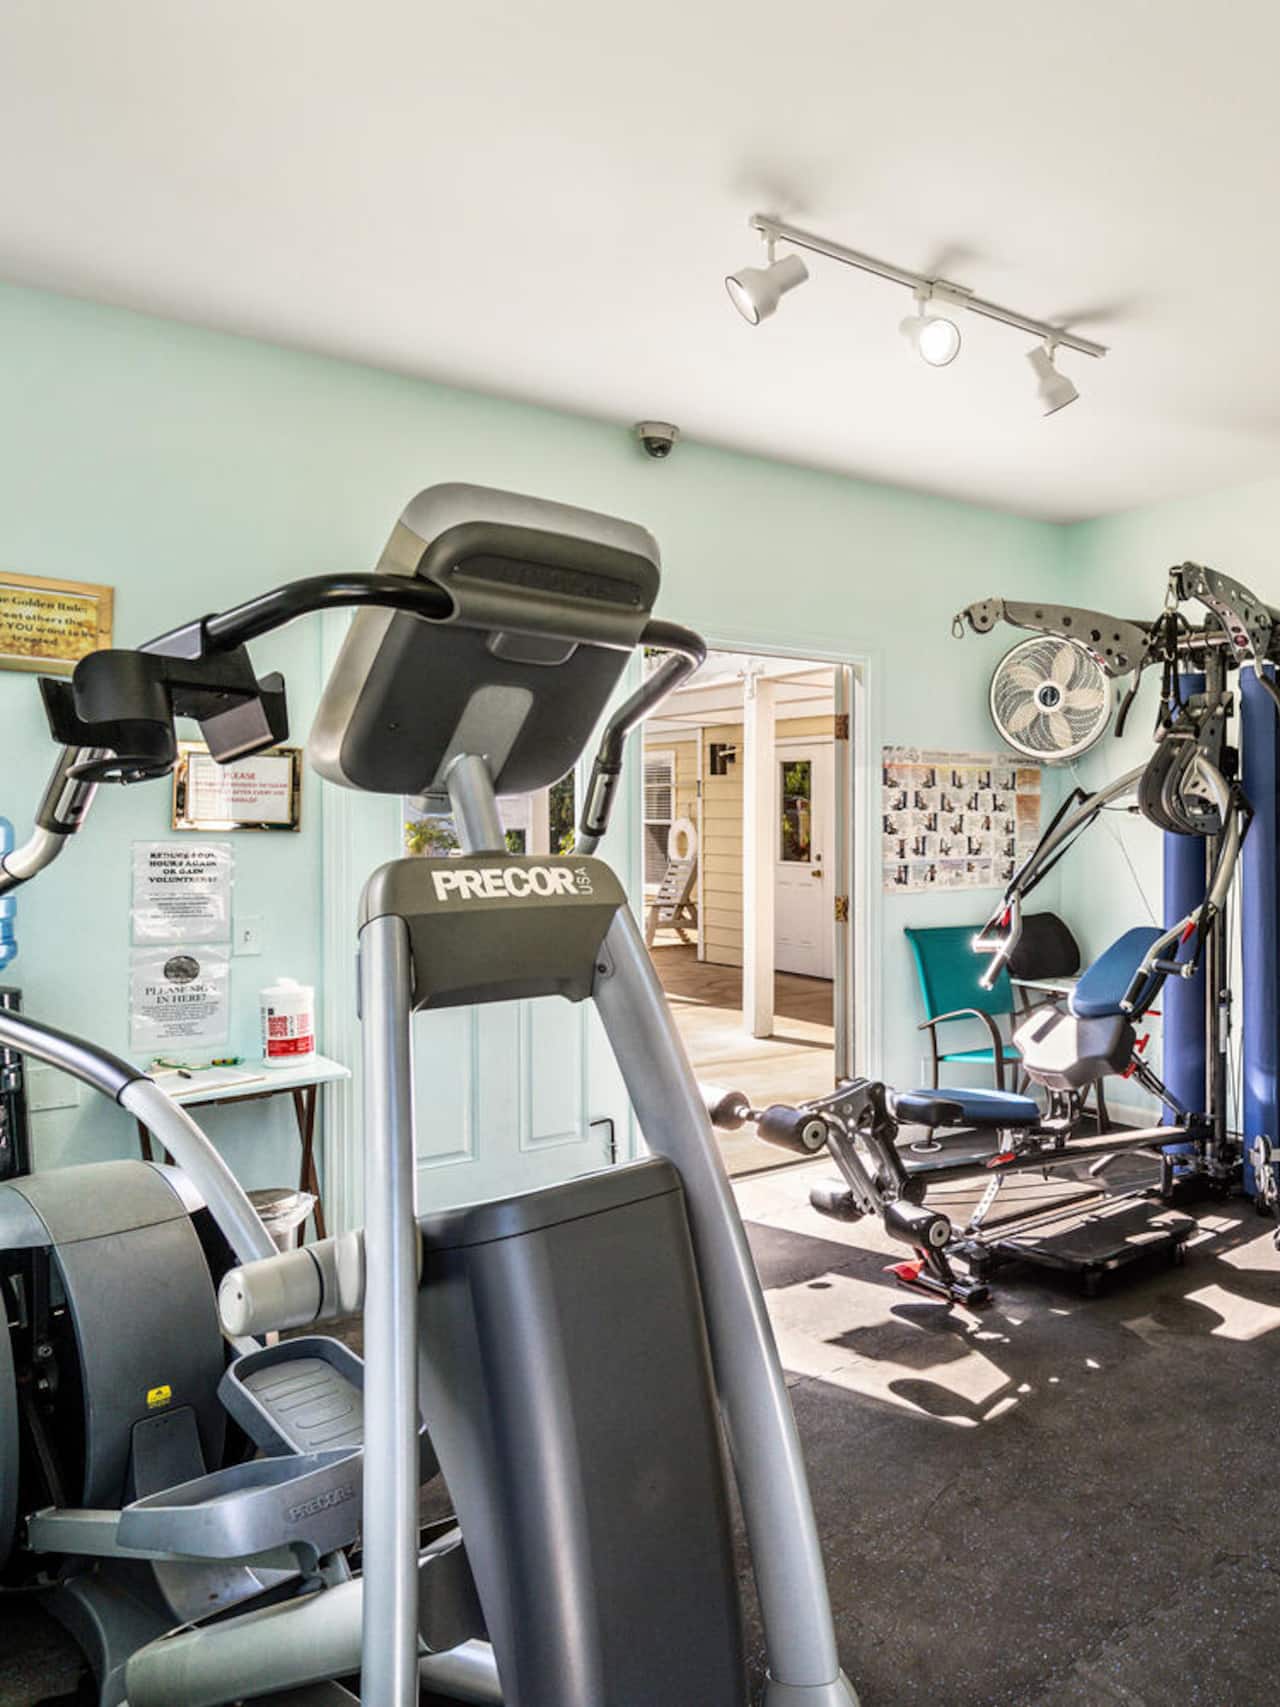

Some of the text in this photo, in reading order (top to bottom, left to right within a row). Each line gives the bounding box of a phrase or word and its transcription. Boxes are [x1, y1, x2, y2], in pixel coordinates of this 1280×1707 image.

[12, 597, 55, 609] Golden
[25, 614, 63, 624] others
[7, 622, 33, 632] YOU
[36, 626, 66, 636] want
[68, 628, 80, 636] to
[149, 860, 183, 868] HOURS
[431, 866, 594, 901] PRECOR USA
